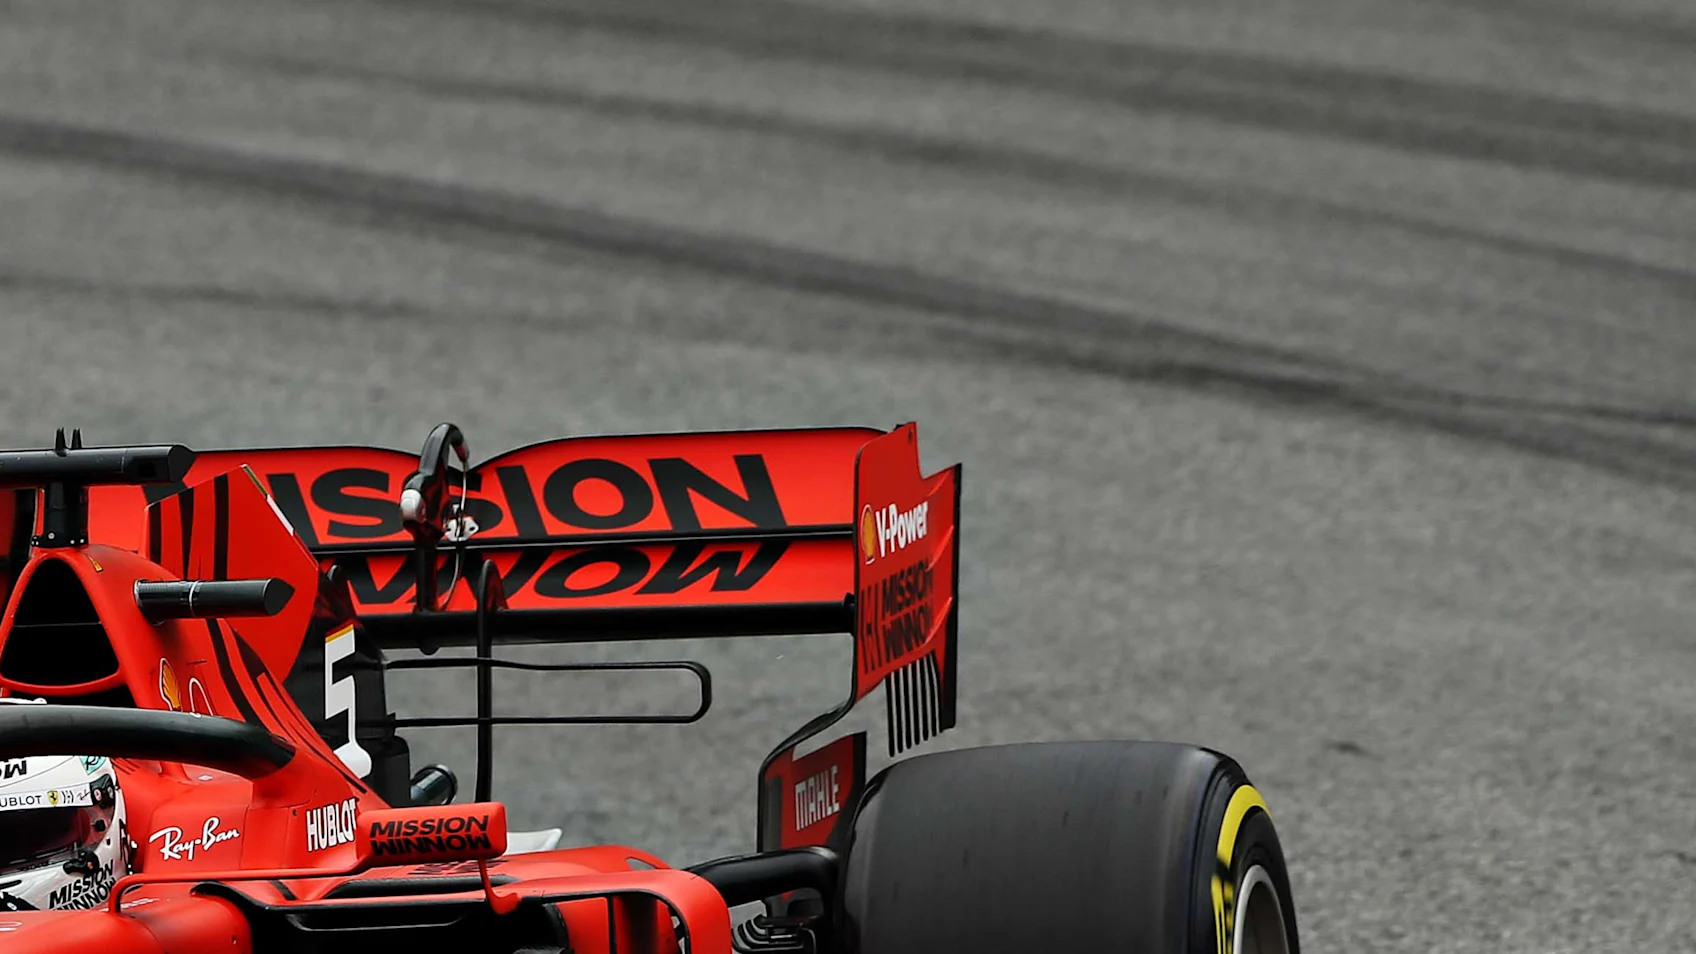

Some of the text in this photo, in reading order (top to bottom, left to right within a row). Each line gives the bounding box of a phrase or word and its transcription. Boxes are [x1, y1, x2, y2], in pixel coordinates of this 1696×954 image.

[267, 454, 788, 548] ISSION
[875, 501, 928, 557] V-Power
[324, 624, 372, 779] 5
[795, 766, 840, 831] MAHLE
[149, 817, 240, 860] Ray-Ban
[369, 815, 489, 838] MISSION
[370, 833, 491, 856] WINNOW
[49, 861, 112, 907] MISSION
